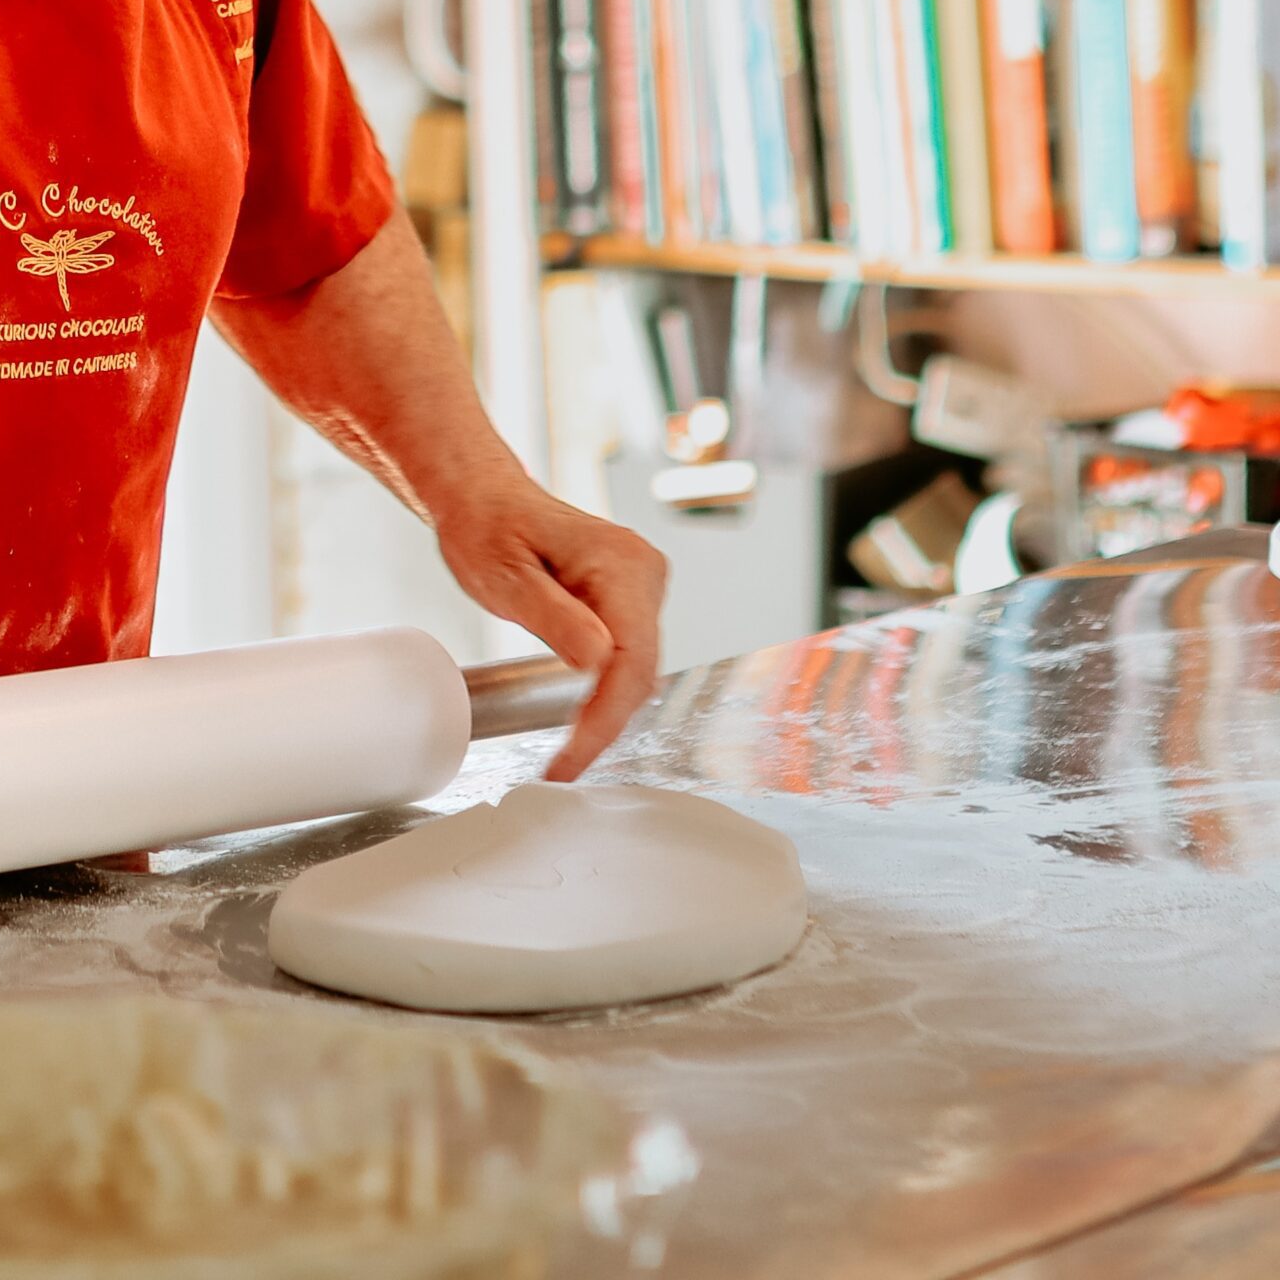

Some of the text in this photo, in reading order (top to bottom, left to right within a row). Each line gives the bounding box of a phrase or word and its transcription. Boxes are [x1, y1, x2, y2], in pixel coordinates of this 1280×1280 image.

[42, 182, 165, 257] Chocolatier
[60, 315, 145, 339] CHOCOLATES
[55, 358, 70, 376] IN
[73, 351, 138, 375] CAITHNESS
